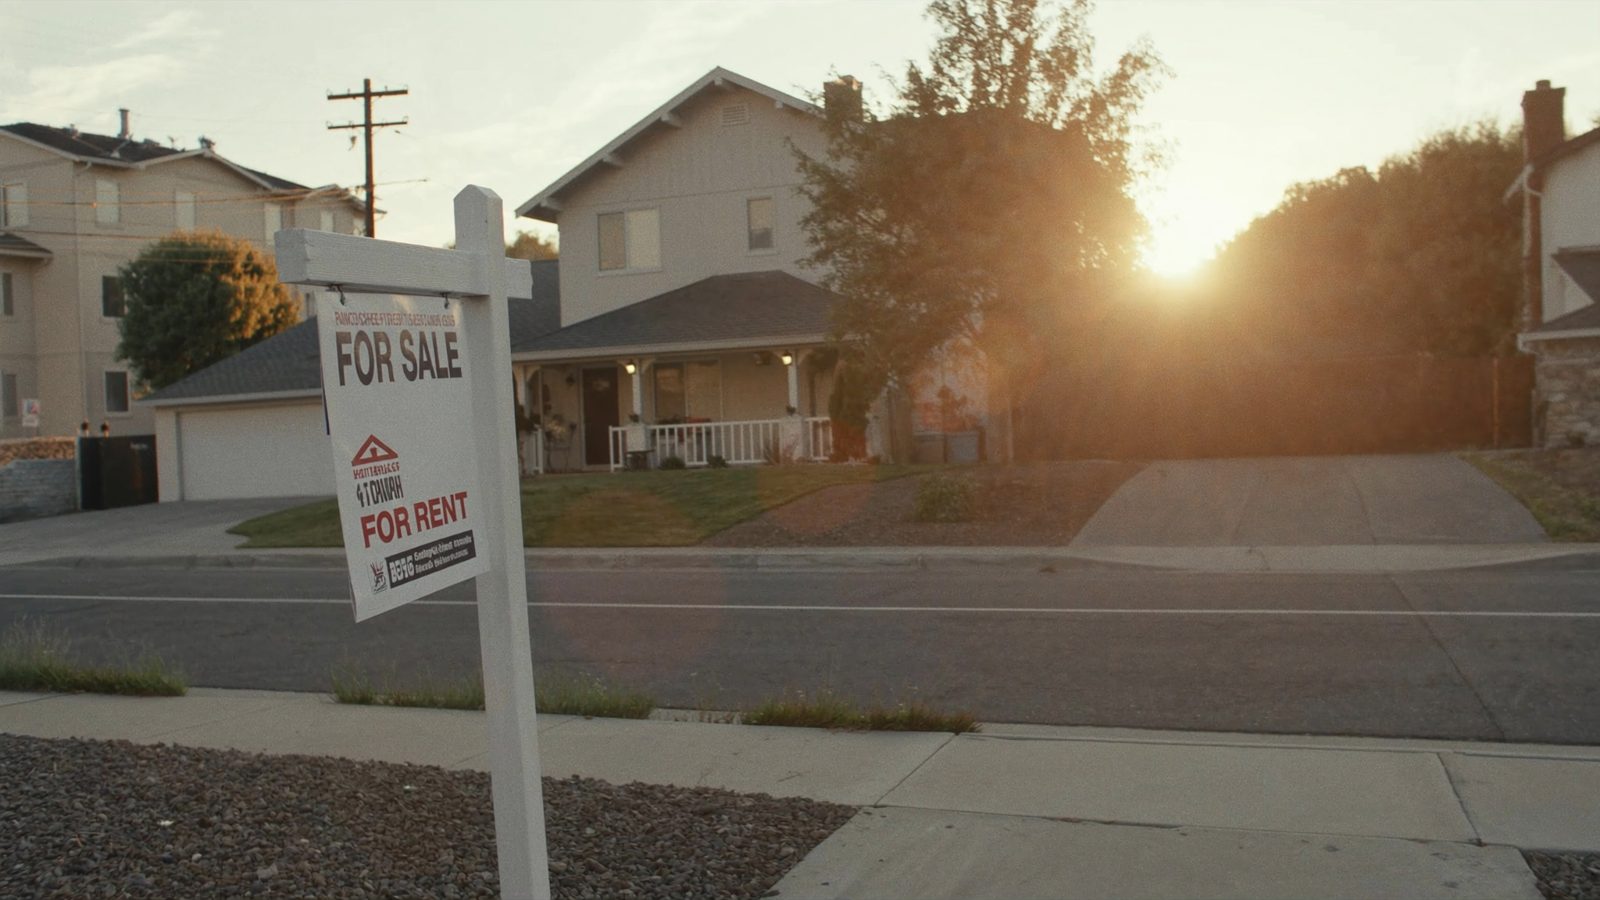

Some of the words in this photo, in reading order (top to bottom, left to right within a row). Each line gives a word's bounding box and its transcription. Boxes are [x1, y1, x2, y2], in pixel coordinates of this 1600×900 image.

[336, 330, 394, 386] FOR
[400, 330, 462, 382] SALE
[361, 506, 412, 548] FOR
[414, 492, 467, 532] RENT
